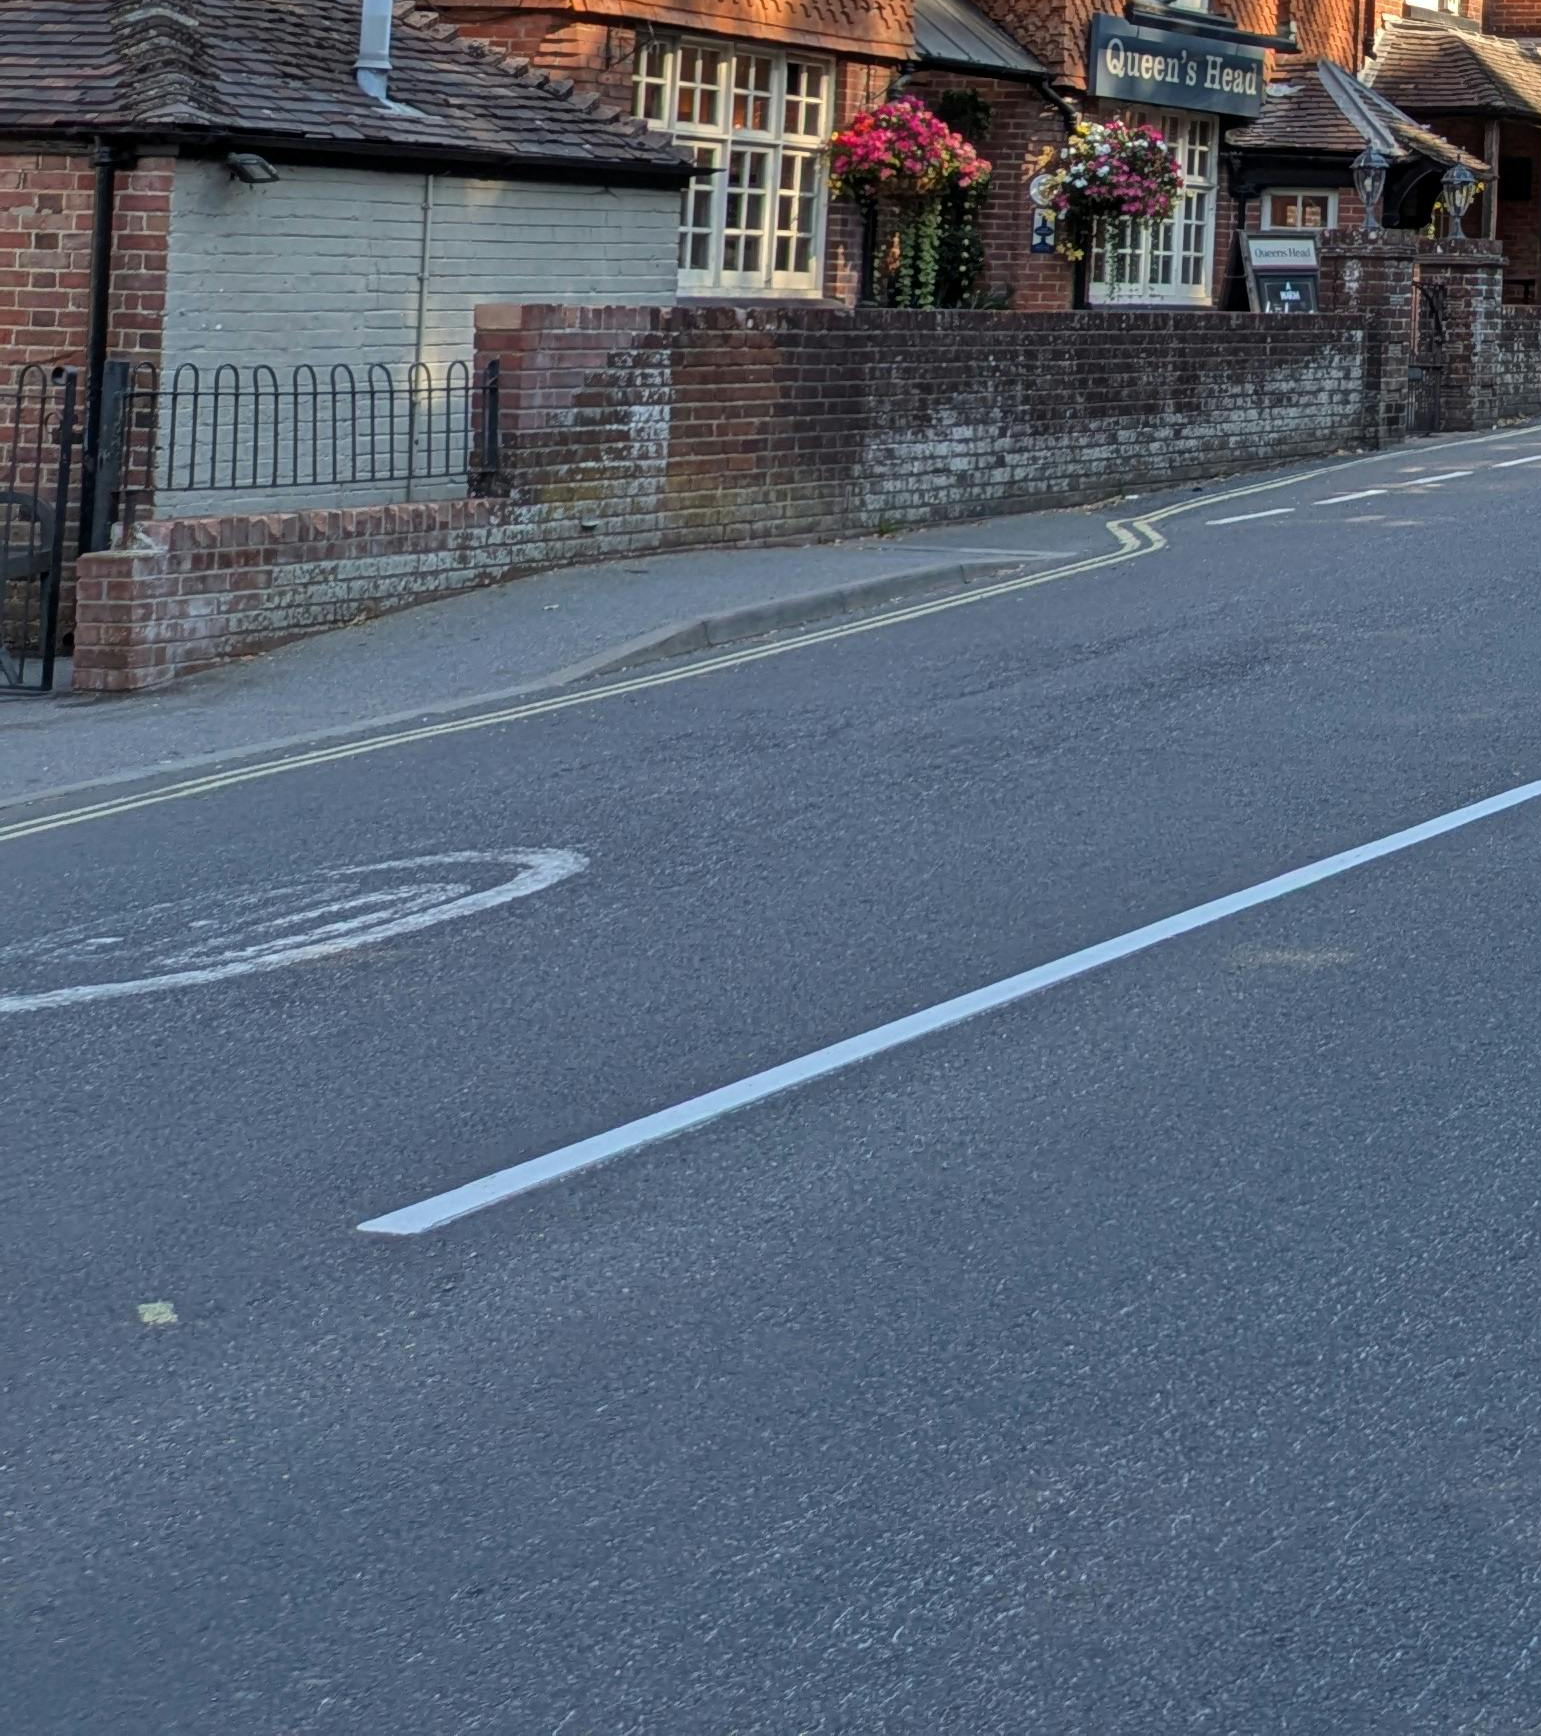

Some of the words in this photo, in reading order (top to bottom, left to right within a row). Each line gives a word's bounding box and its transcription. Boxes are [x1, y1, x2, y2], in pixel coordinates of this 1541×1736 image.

[1105, 37, 1198, 87] Queen's
[1203, 54, 1257, 96] Head
[1288, 247, 1311, 258] Head
